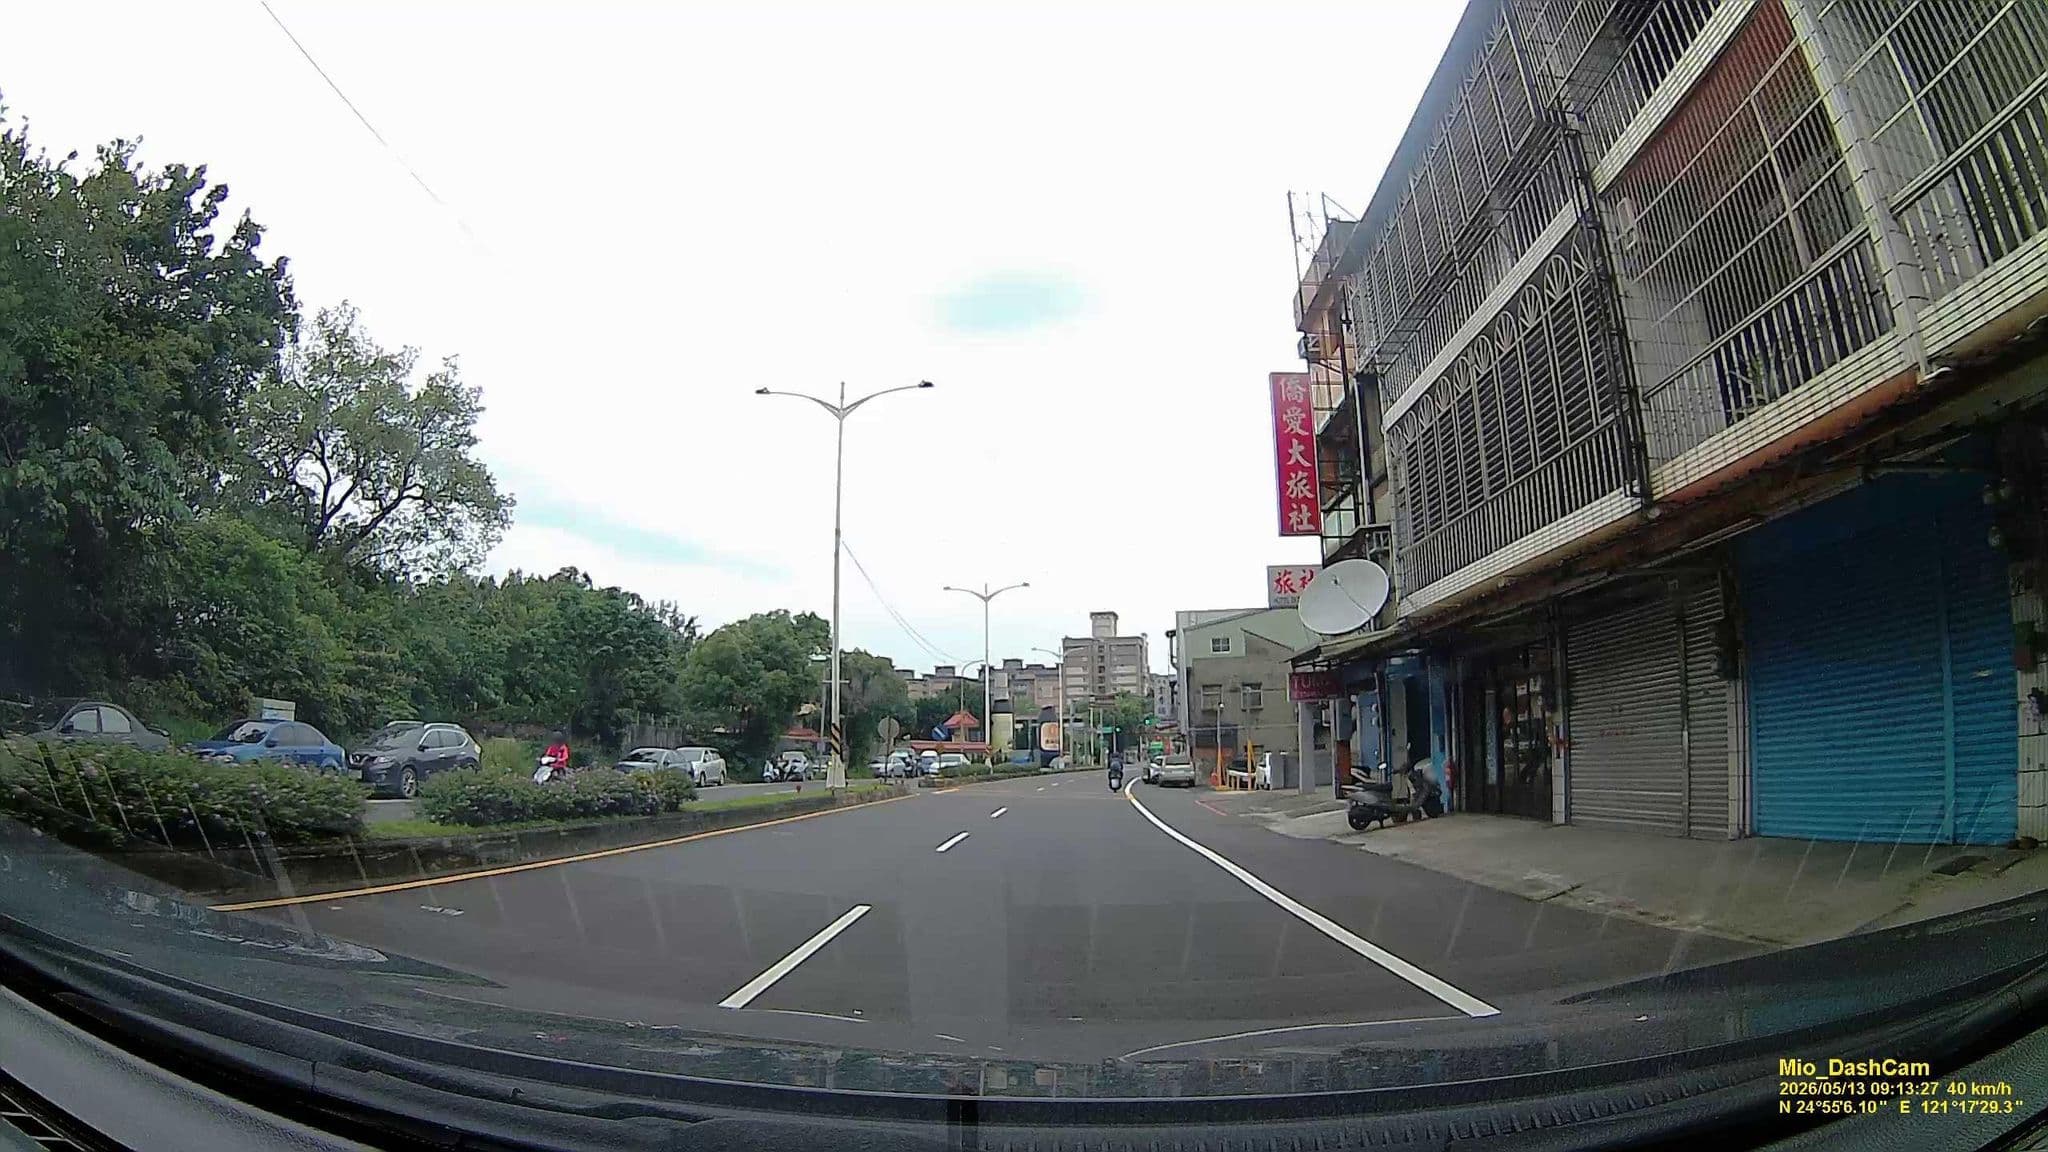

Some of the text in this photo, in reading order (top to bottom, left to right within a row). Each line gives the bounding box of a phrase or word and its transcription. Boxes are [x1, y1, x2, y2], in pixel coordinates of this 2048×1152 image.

[1280, 376, 1315, 532] 僑愛大旅社
